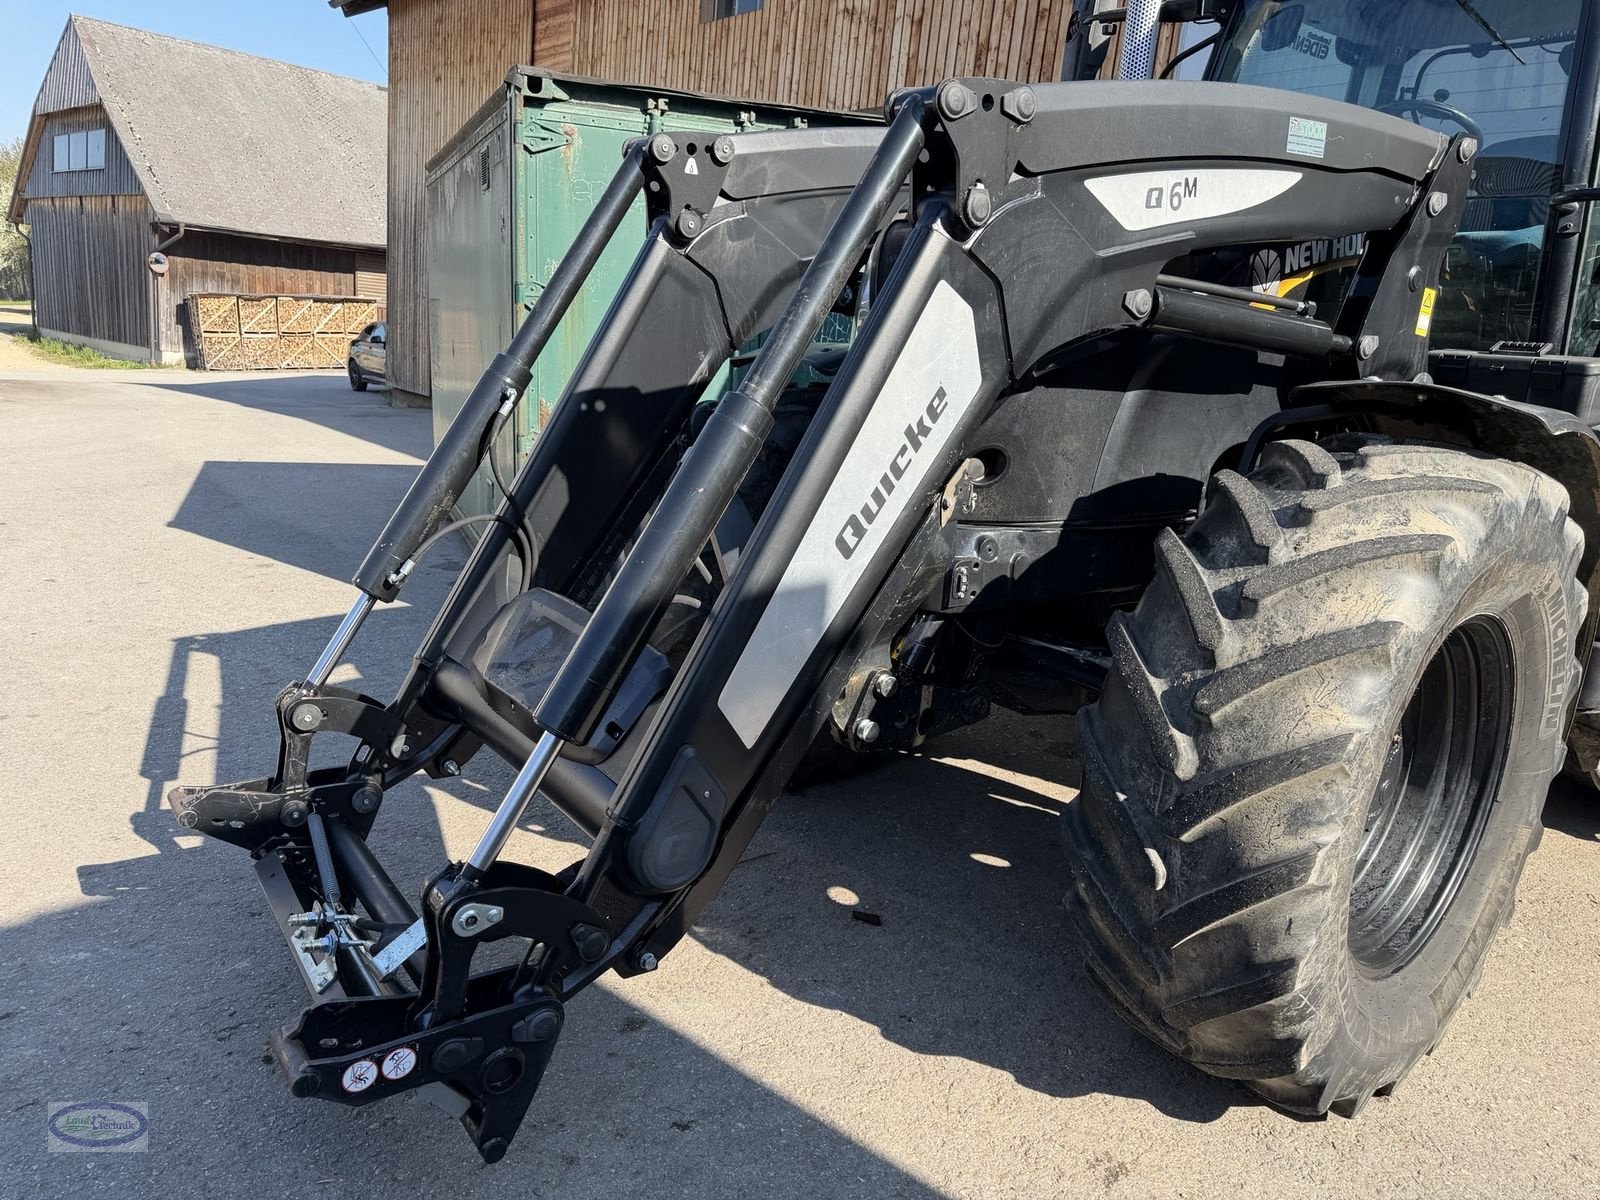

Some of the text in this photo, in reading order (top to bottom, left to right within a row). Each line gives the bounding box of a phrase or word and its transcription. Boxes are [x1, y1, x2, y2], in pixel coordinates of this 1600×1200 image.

[1284, 240, 1329, 275] NEW
[834, 386, 948, 560] Quicke
[1545, 585, 1568, 730] MICHELIN
